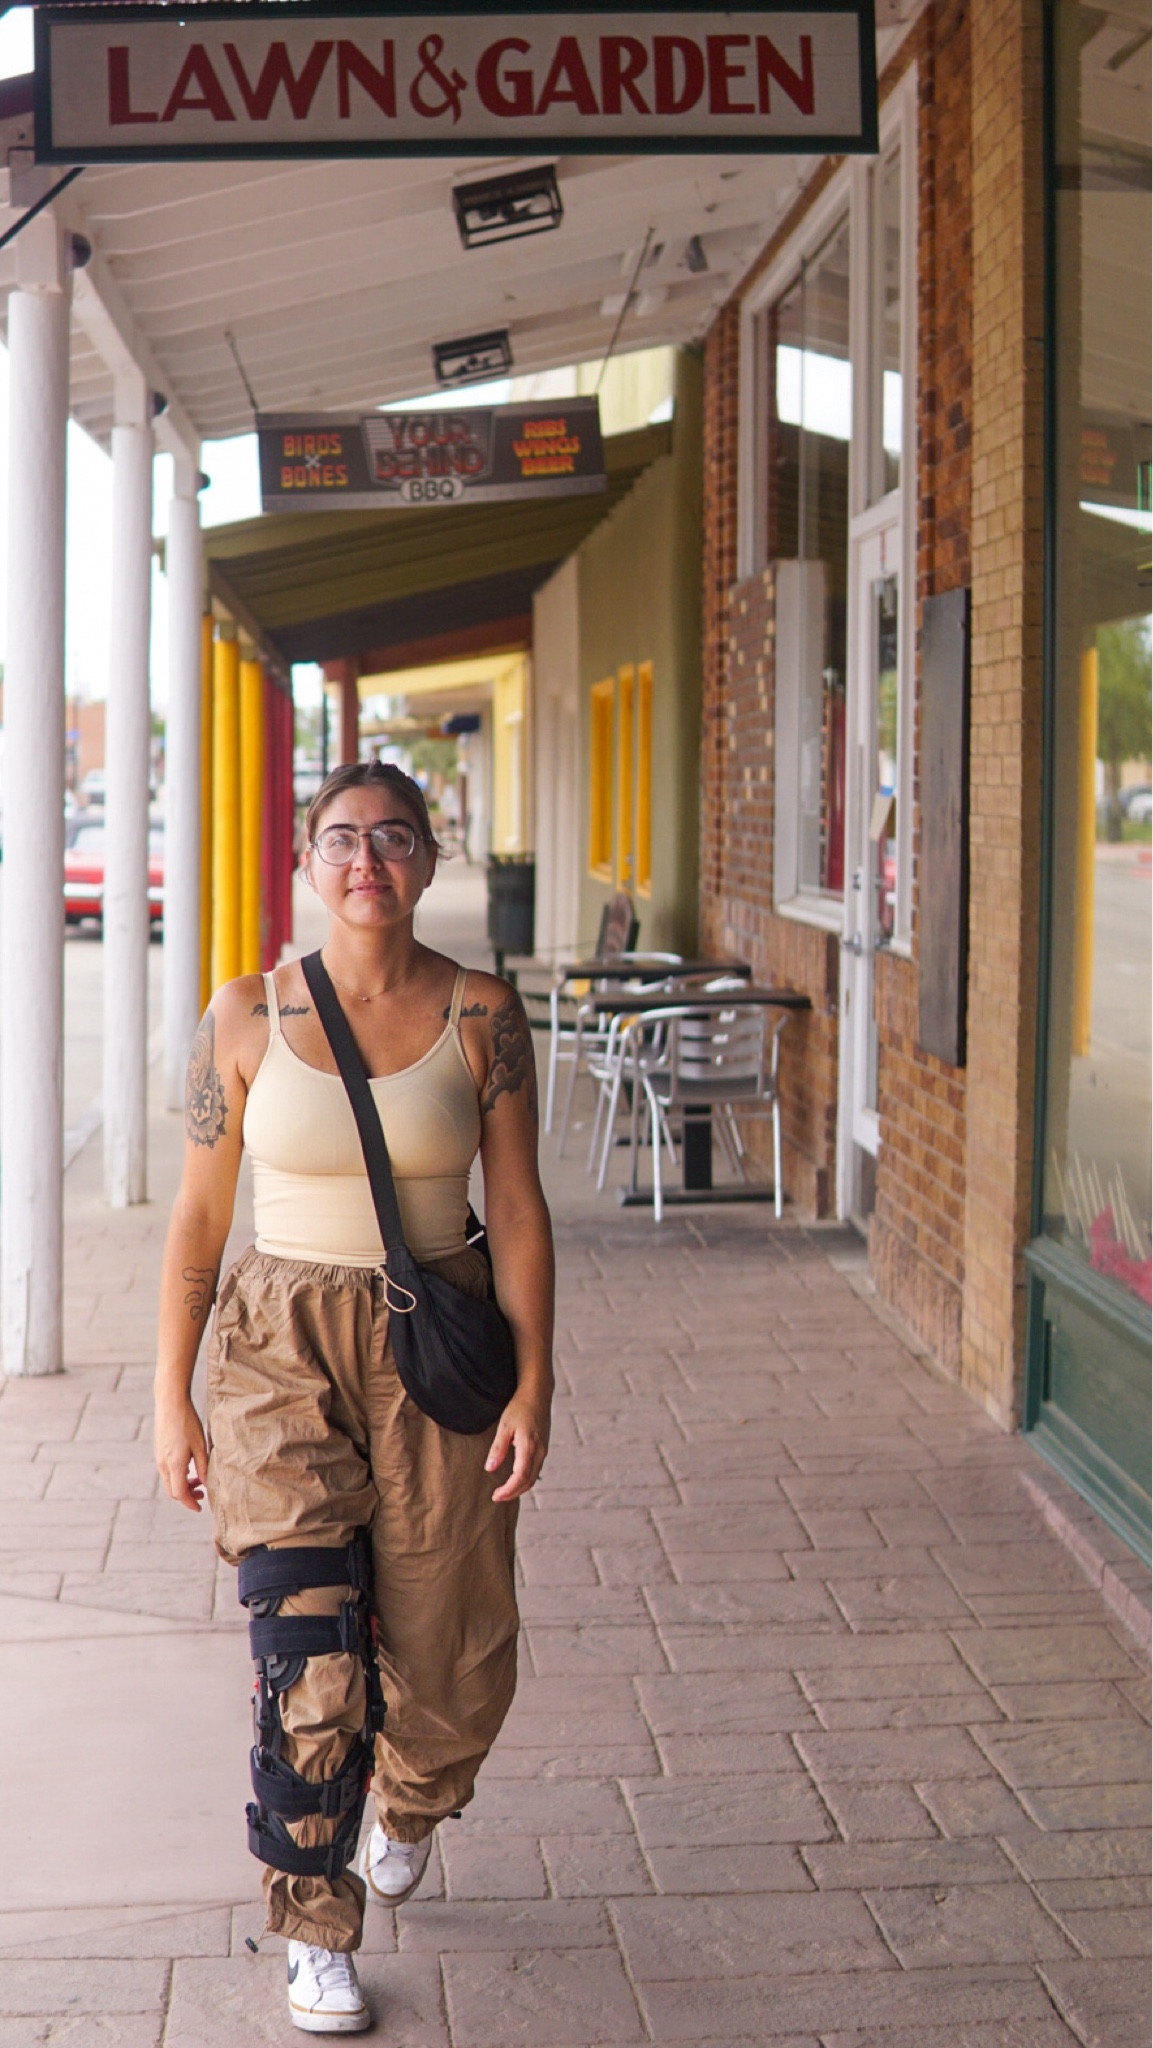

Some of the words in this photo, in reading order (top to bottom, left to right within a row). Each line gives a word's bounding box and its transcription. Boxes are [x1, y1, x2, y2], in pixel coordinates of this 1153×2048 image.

[107, 39, 397, 126] LAWN
[408, 33, 468, 125] &
[477, 34, 815, 118] GARDEN
[384, 415, 471, 448] YOUR
[523, 419, 567, 438] RIBS
[283, 433, 342, 456] BIRDS
[512, 436, 580, 457] WINGS
[375, 446, 484, 479] BEHIND
[521, 456, 574, 476] BEER
[281, 465, 348, 488] BONES
[409, 480, 455, 501] BBQ
